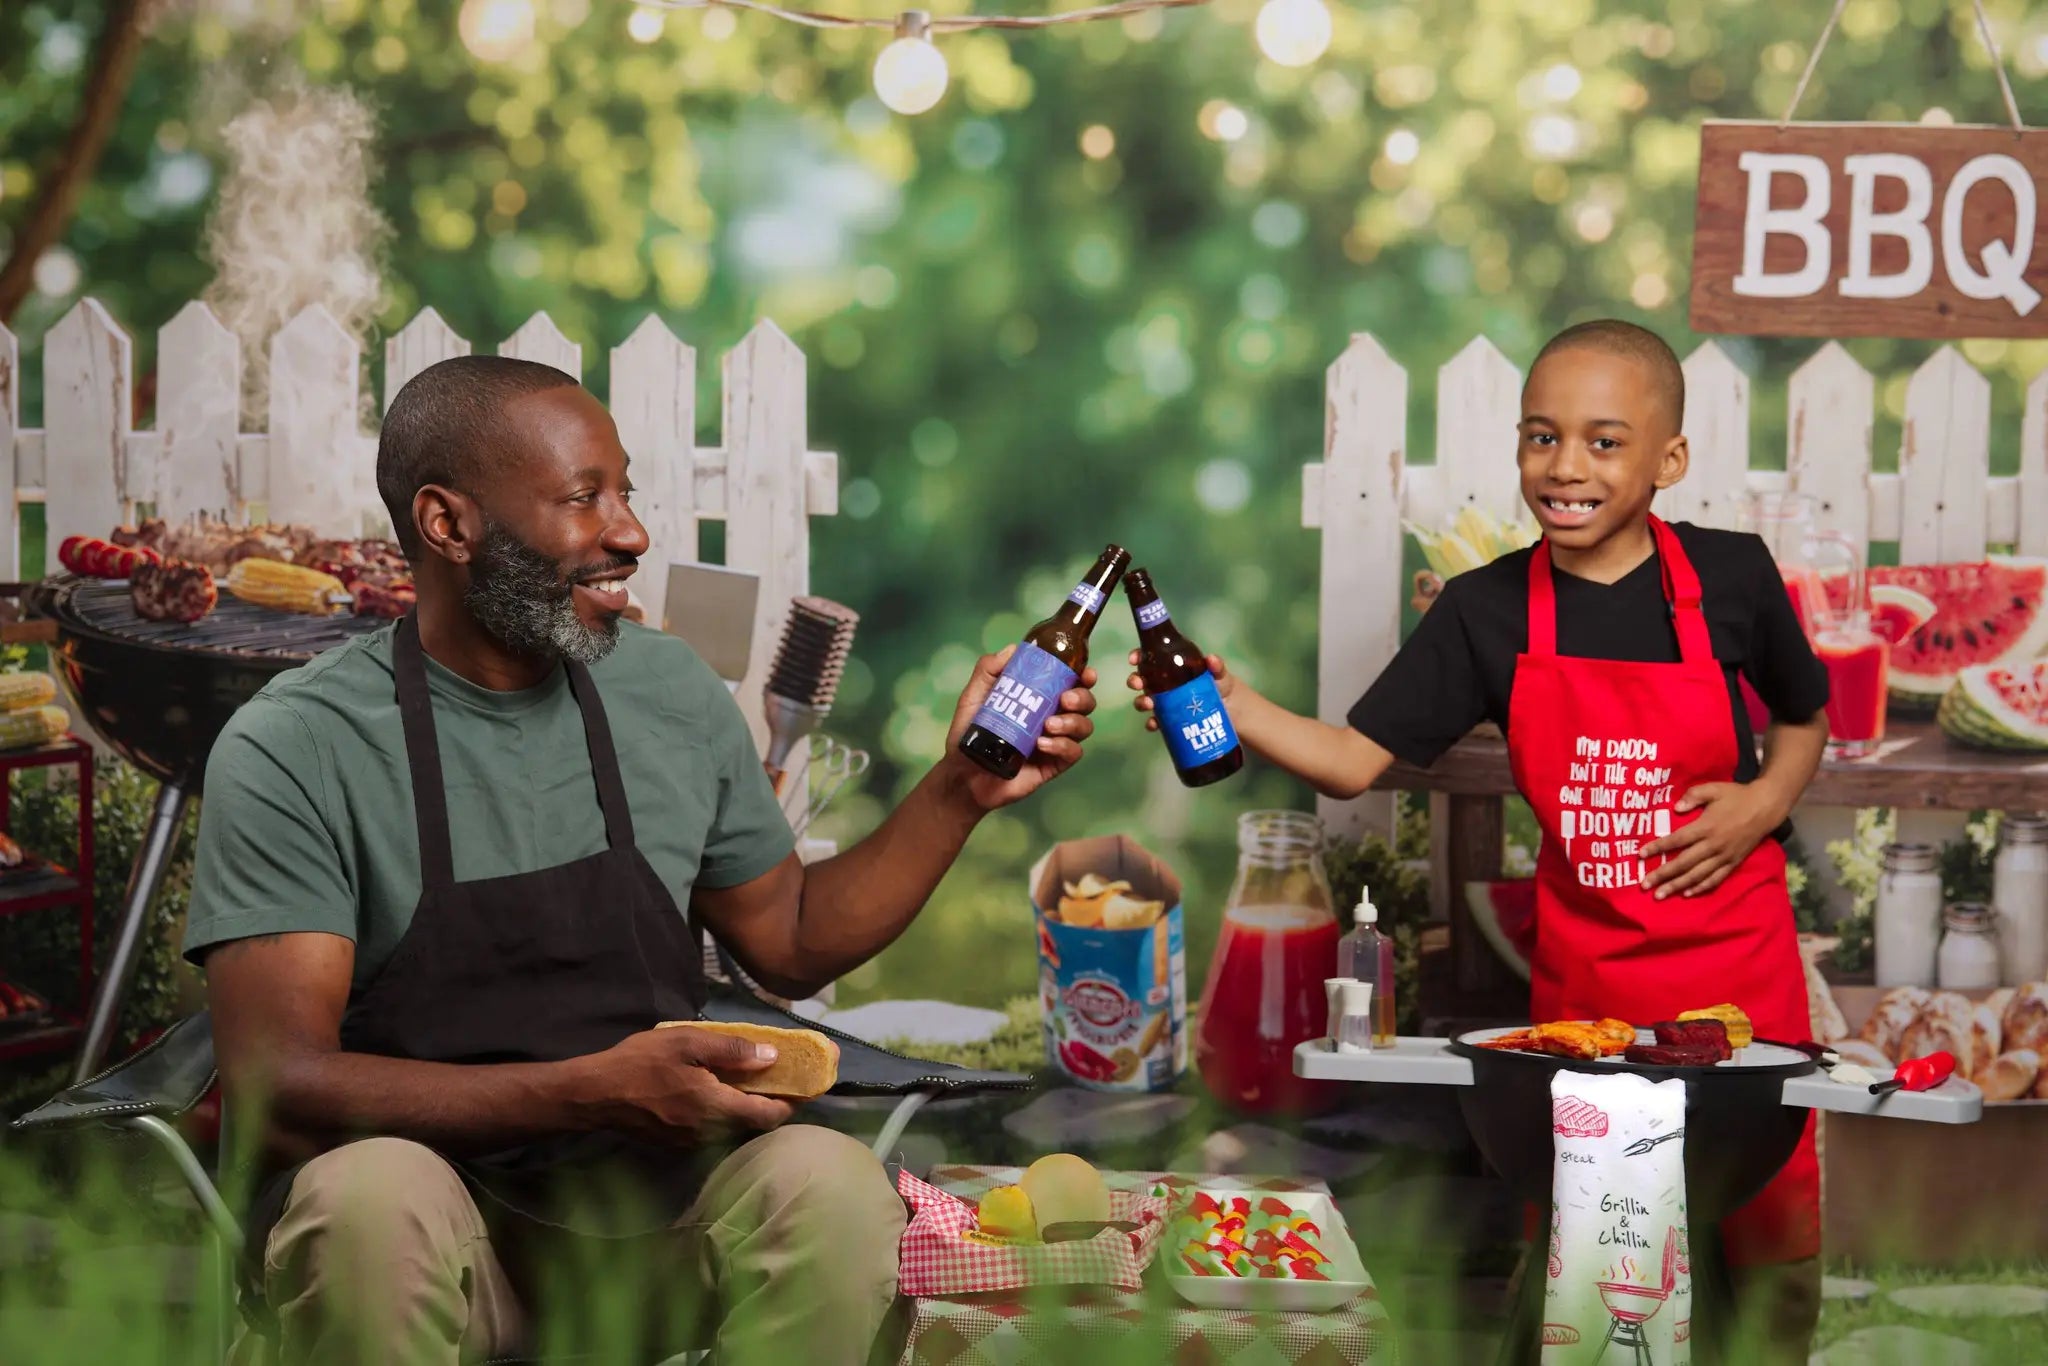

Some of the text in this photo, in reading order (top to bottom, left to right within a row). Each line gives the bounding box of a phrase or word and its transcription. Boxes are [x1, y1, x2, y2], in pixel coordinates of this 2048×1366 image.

[1733, 152, 2042, 317] BBQ
[994, 676, 1044, 712] MJW
[985, 692, 1029, 728] FULL
[1182, 710, 1223, 740] MJW
[1190, 725, 1226, 750] LITE
[1606, 738, 1657, 761] DADDY
[1569, 758, 1671, 786] ISN'T THE ONLY
[1559, 785, 1584, 805] ONE
[1590, 785, 1619, 809] THAT
[1622, 789, 1650, 810] CAN
[1579, 809, 1652, 837] DOWN
[1591, 839, 1640, 858] ON THE
[1600, 1193, 1649, 1215] Grillin
[1619, 1215, 1629, 1228] &
[1598, 1226, 1651, 1248] Chillin
